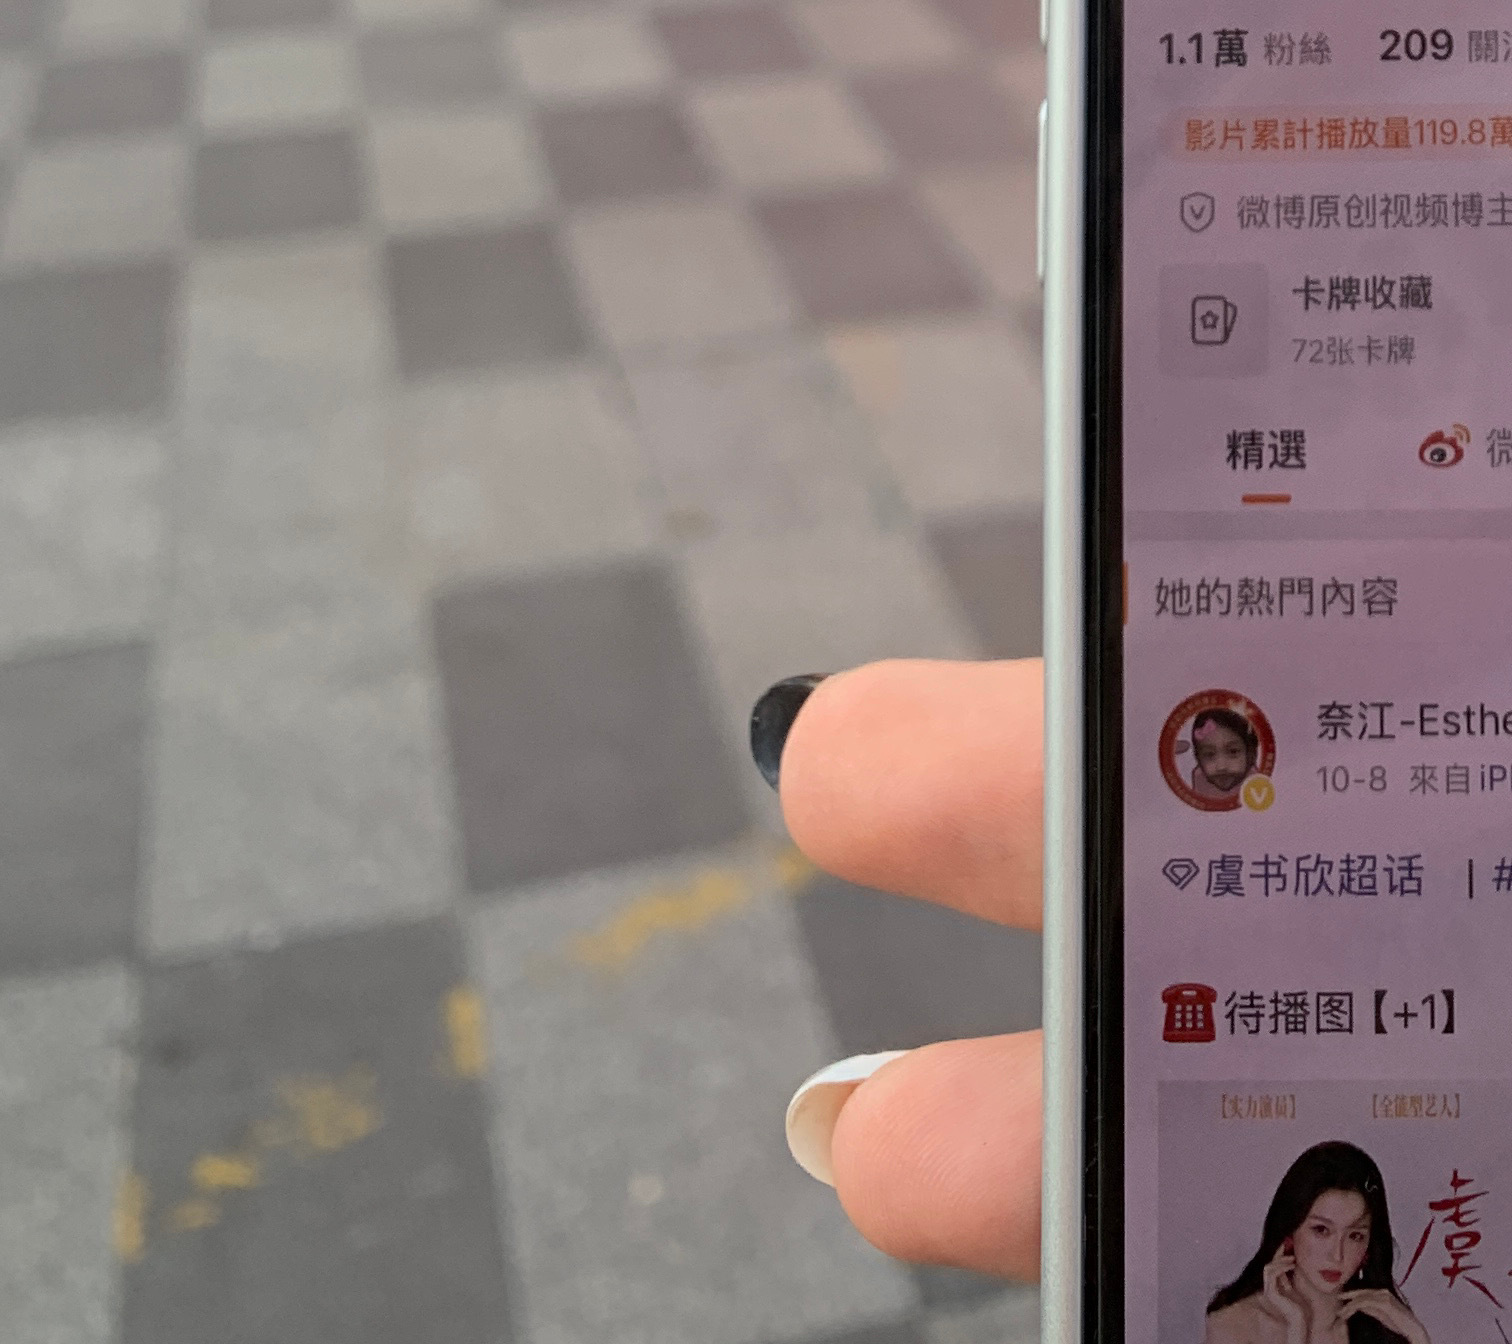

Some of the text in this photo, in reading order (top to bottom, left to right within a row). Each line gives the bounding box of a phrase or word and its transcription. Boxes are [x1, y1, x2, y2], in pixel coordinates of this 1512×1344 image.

[1263, 31, 1333, 66] 粉絲
[1379, 28, 1454, 62] 209
[1291, 274, 1434, 312] 卡牌收藏
[1291, 334, 1416, 366] 72张卡牌
[1225, 428, 1308, 471] 精選
[1154, 574, 1399, 618] 她的熱門內容
[1316, 765, 1388, 795] 10-8
[1205, 853, 1425, 899] 虞书欣超话
